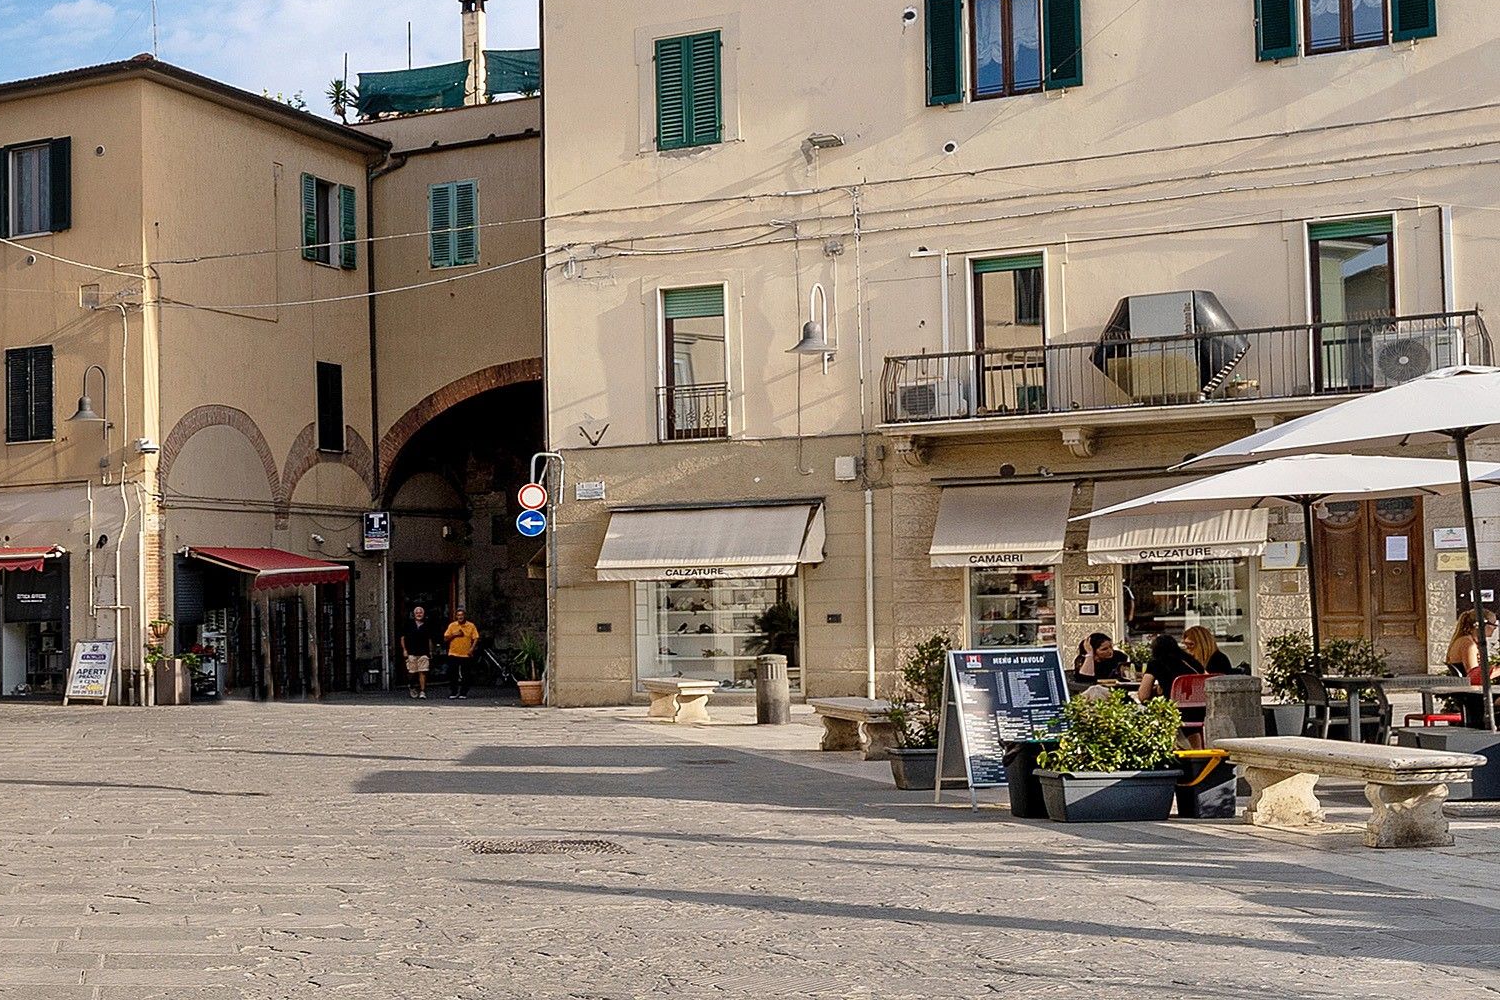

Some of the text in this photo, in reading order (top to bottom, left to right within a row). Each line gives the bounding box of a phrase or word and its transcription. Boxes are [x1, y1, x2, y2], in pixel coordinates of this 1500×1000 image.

[369, 513, 384, 529] T
[1139, 547, 1211, 559] CALZATURE
[969, 554, 1023, 563] CAMARRI
[665, 567, 724, 577] CALZATURE
[1019, 655, 1045, 664] TAVOLO
